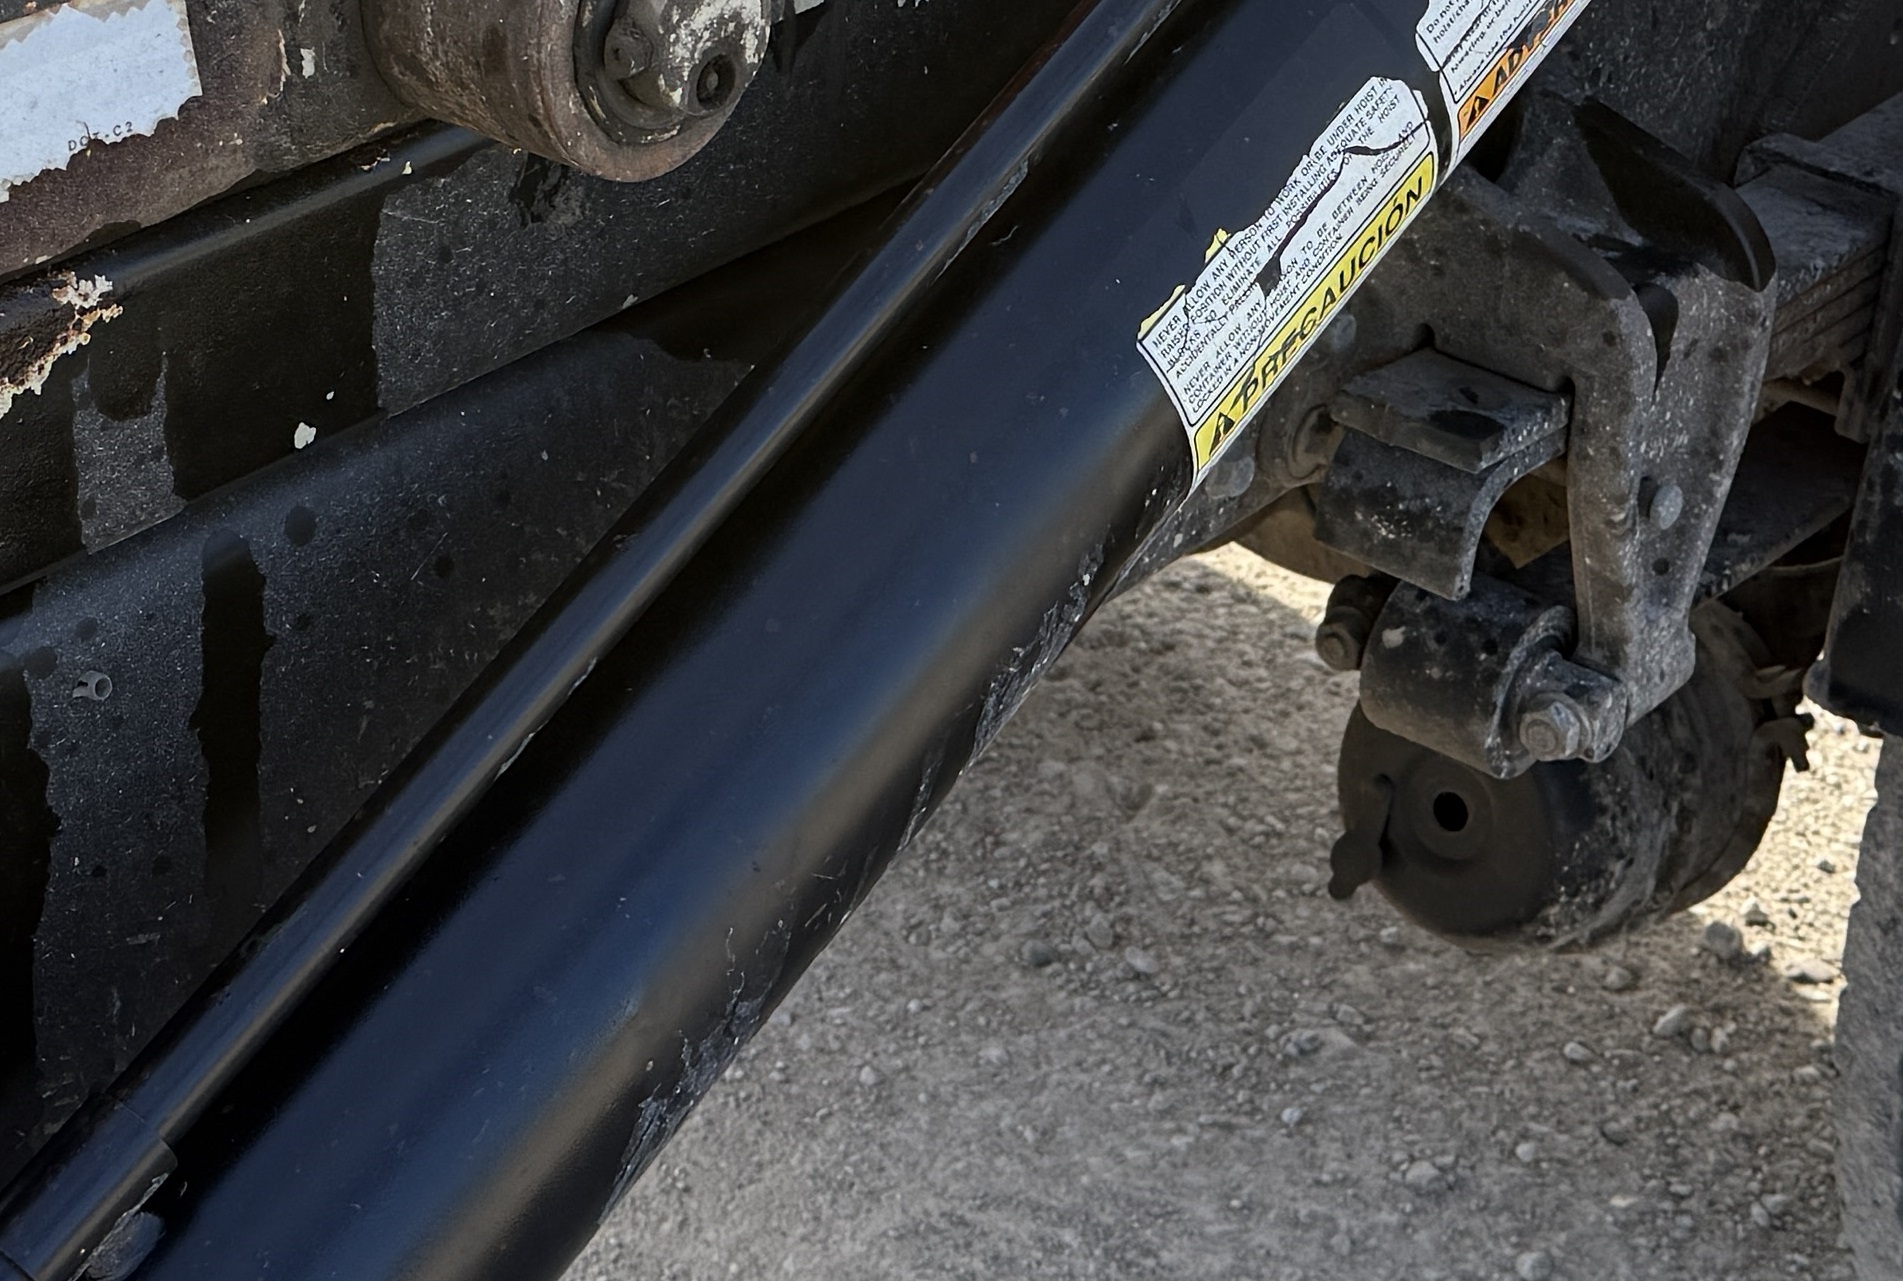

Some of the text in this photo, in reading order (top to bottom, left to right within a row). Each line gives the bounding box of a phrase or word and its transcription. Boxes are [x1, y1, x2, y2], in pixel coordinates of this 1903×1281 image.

[1211, 258, 1229, 282] ANY
[1326, 113, 1355, 147] UNDER
[1353, 85, 1378, 115] HOIST
[1221, 256, 1261, 306] ELIMINATE
[1266, 235, 1283, 254] ALL
[1357, 126, 1375, 145] THE
[1377, 93, 1400, 124] HOIST
[1225, 238, 1261, 282] WITHOUT
[1260, 213, 1283, 243] FIRST
[1281, 163, 1327, 217] INSTALLING
[1183, 360, 1211, 395] NEVER
[1215, 322, 1242, 360] ALLOW
[1246, 299, 1262, 322] ANY
